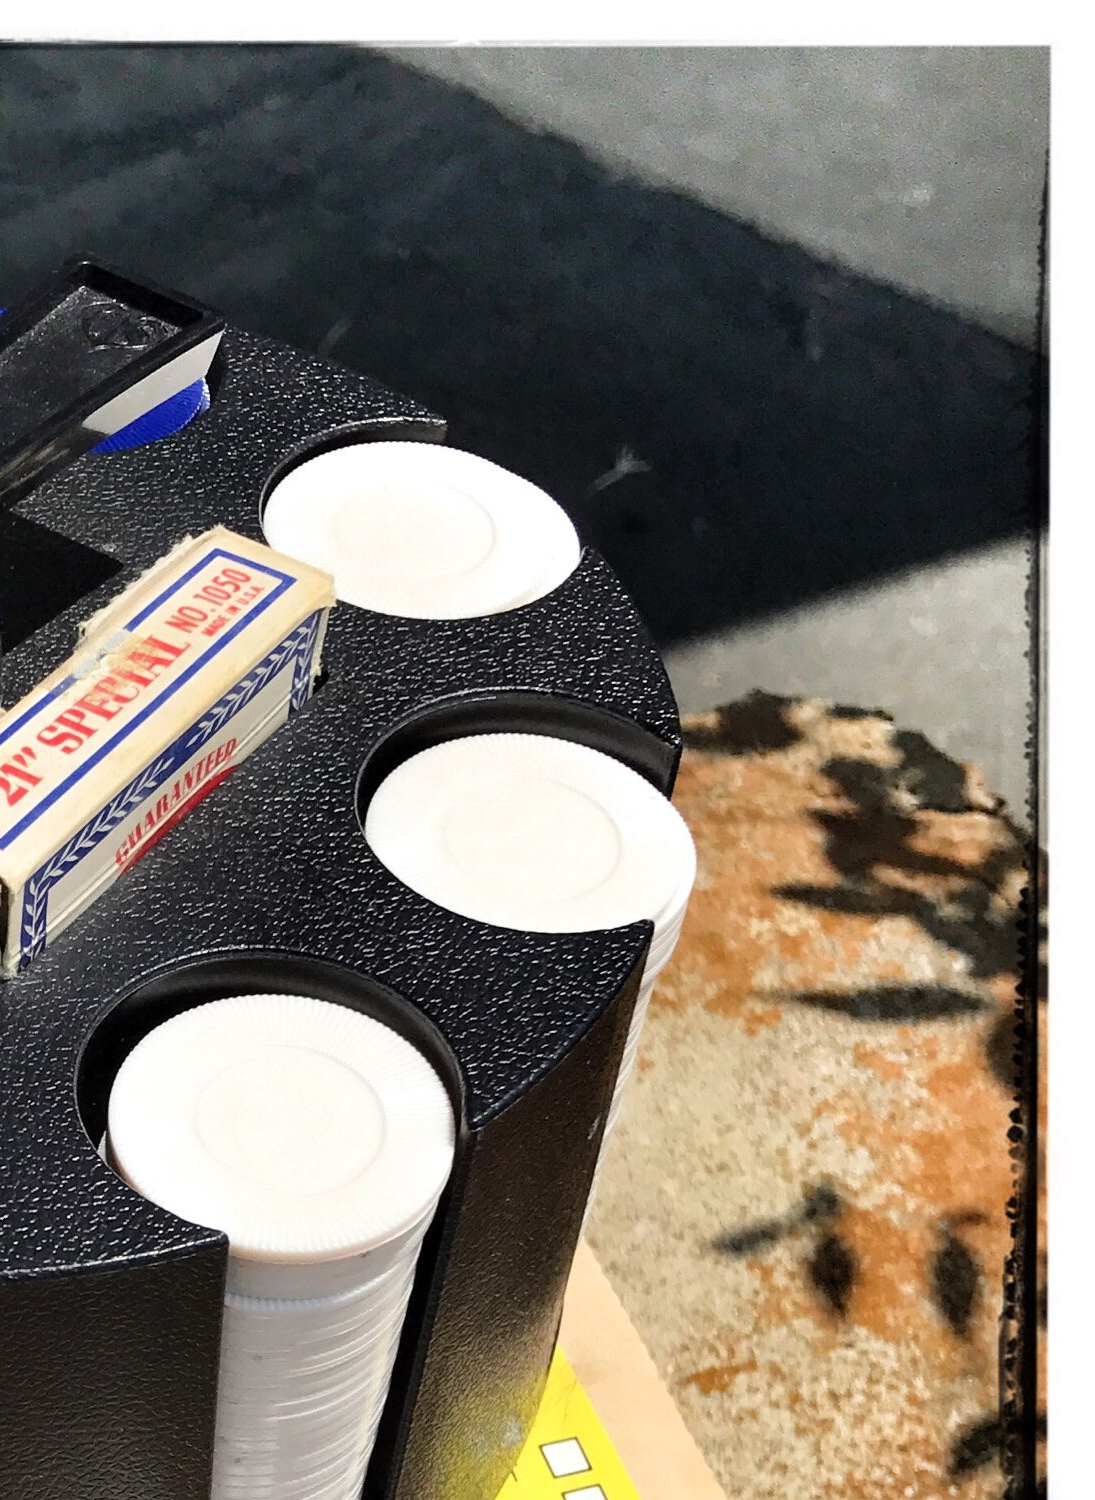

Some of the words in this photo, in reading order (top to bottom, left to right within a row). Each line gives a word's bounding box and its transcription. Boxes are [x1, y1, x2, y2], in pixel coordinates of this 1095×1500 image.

[201, 614, 231, 638] MADE
[225, 604, 242, 616] IN
[36, 634, 192, 755] SPECIAL
[114, 737, 238, 868] GUARANTEED
